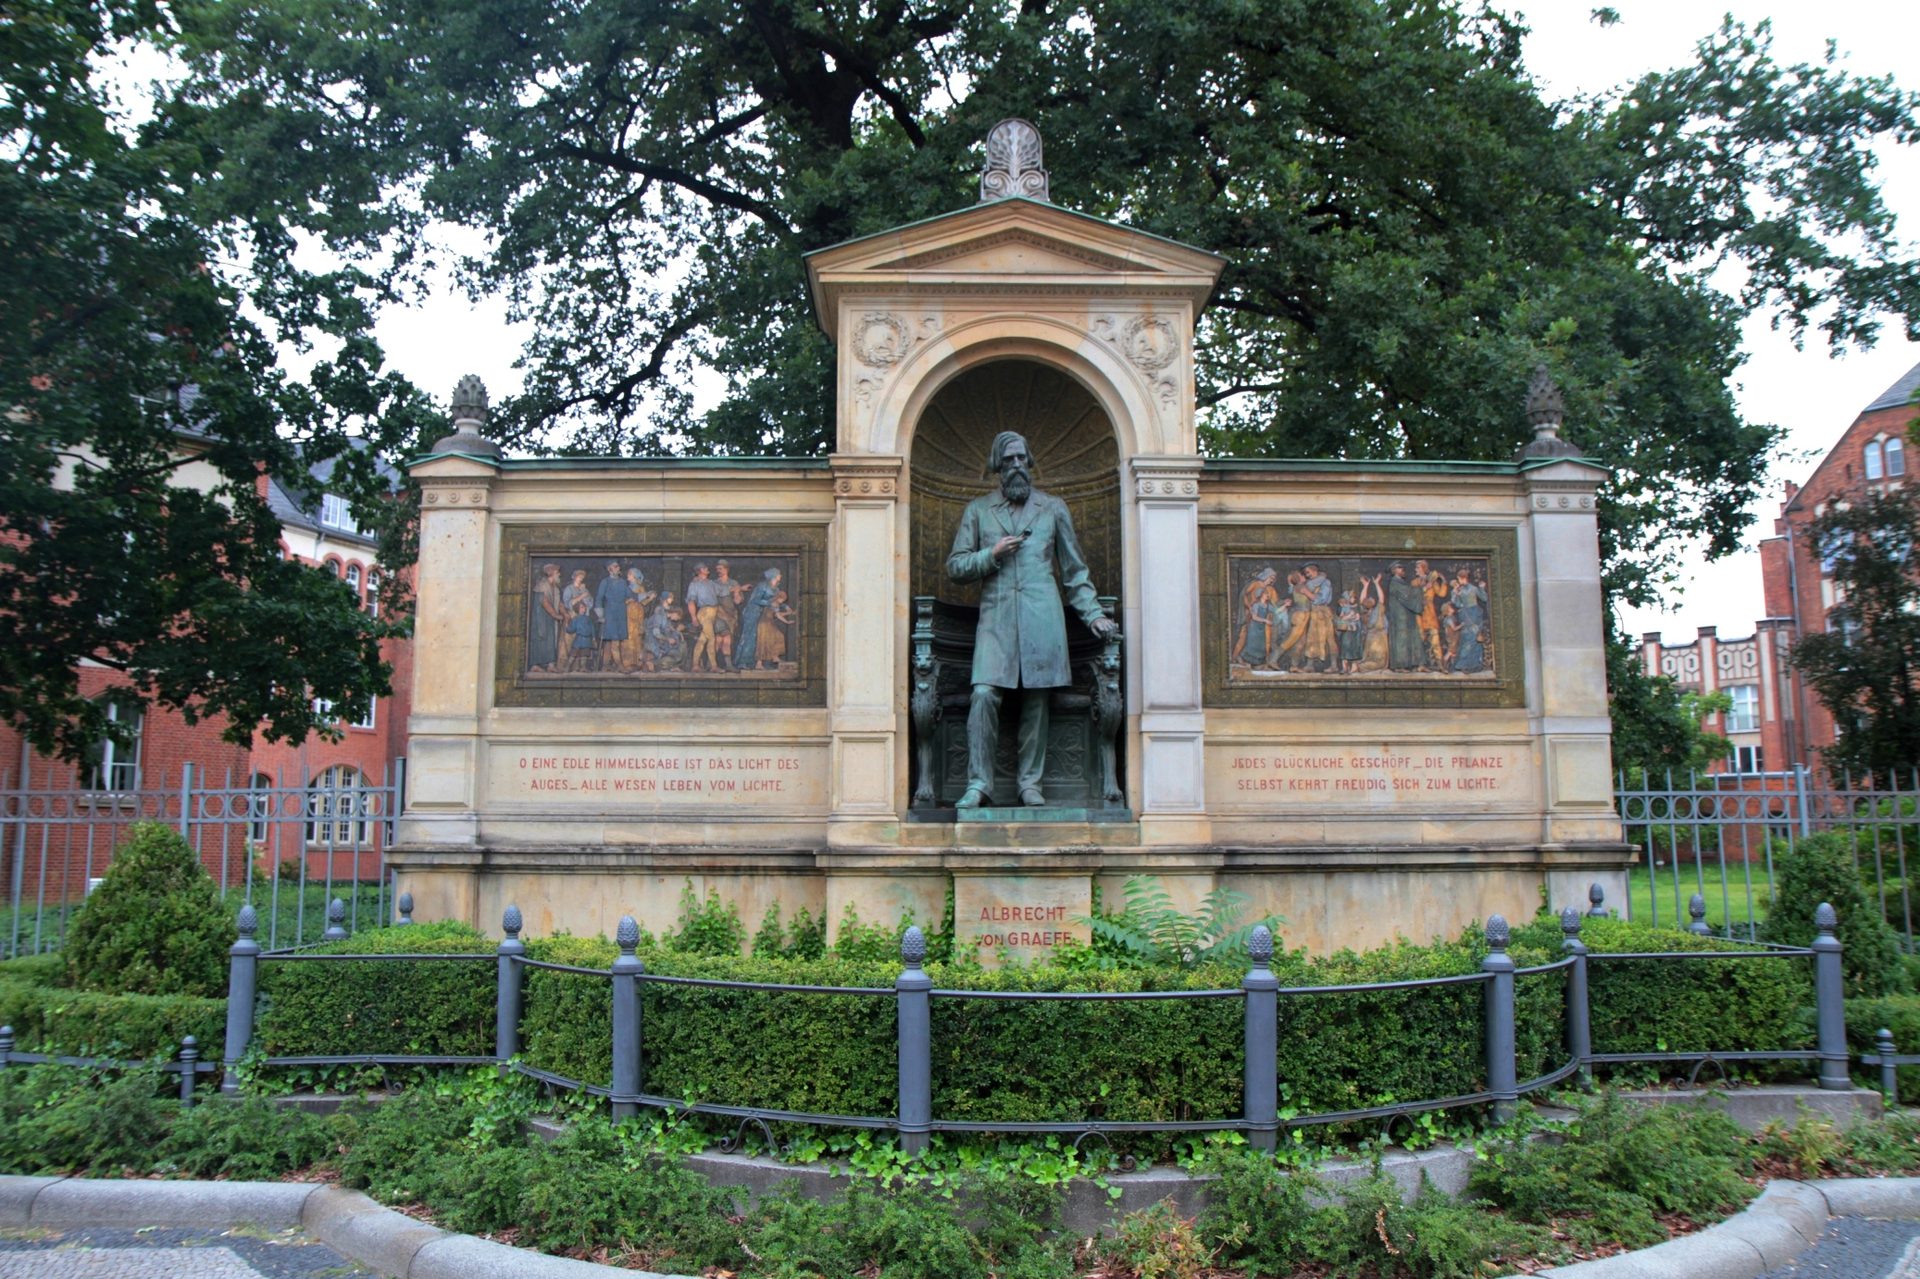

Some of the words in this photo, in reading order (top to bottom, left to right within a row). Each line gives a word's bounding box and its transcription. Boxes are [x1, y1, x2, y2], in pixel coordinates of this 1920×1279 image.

[519, 758, 528, 769] O
[532, 758, 557, 769] EINE
[563, 758, 590, 769] EDLE
[595, 758, 679, 769] HIMMELSGABE
[685, 758, 702, 770] IST
[708, 758, 733, 770] DAS
[738, 758, 771, 770] LICHT
[777, 758, 800, 770] DES
[1231, 757, 1266, 769] JEDES
[1274, 754, 1344, 769] GLÜCKLICHE
[1424, 757, 1443, 769] DIE
[1452, 757, 1503, 769] PFLANZE
[581, 779, 608, 791] ALLE
[614, 779, 656, 791] WESEN
[663, 779, 702, 791] LEBEN
[710, 779, 736, 791] VOM
[1238, 778, 1283, 790] SELBST
[1289, 778, 1329, 790] KEHRT
[1335, 778, 1386, 790] FREUDIG
[1392, 778, 1419, 790] SICH
[1426, 778, 1451, 790] ZUM
[980, 906, 1066, 921] ALBRECHT
[976, 934, 1004, 946] VON
[1008, 932, 1072, 947] GRAEFE
